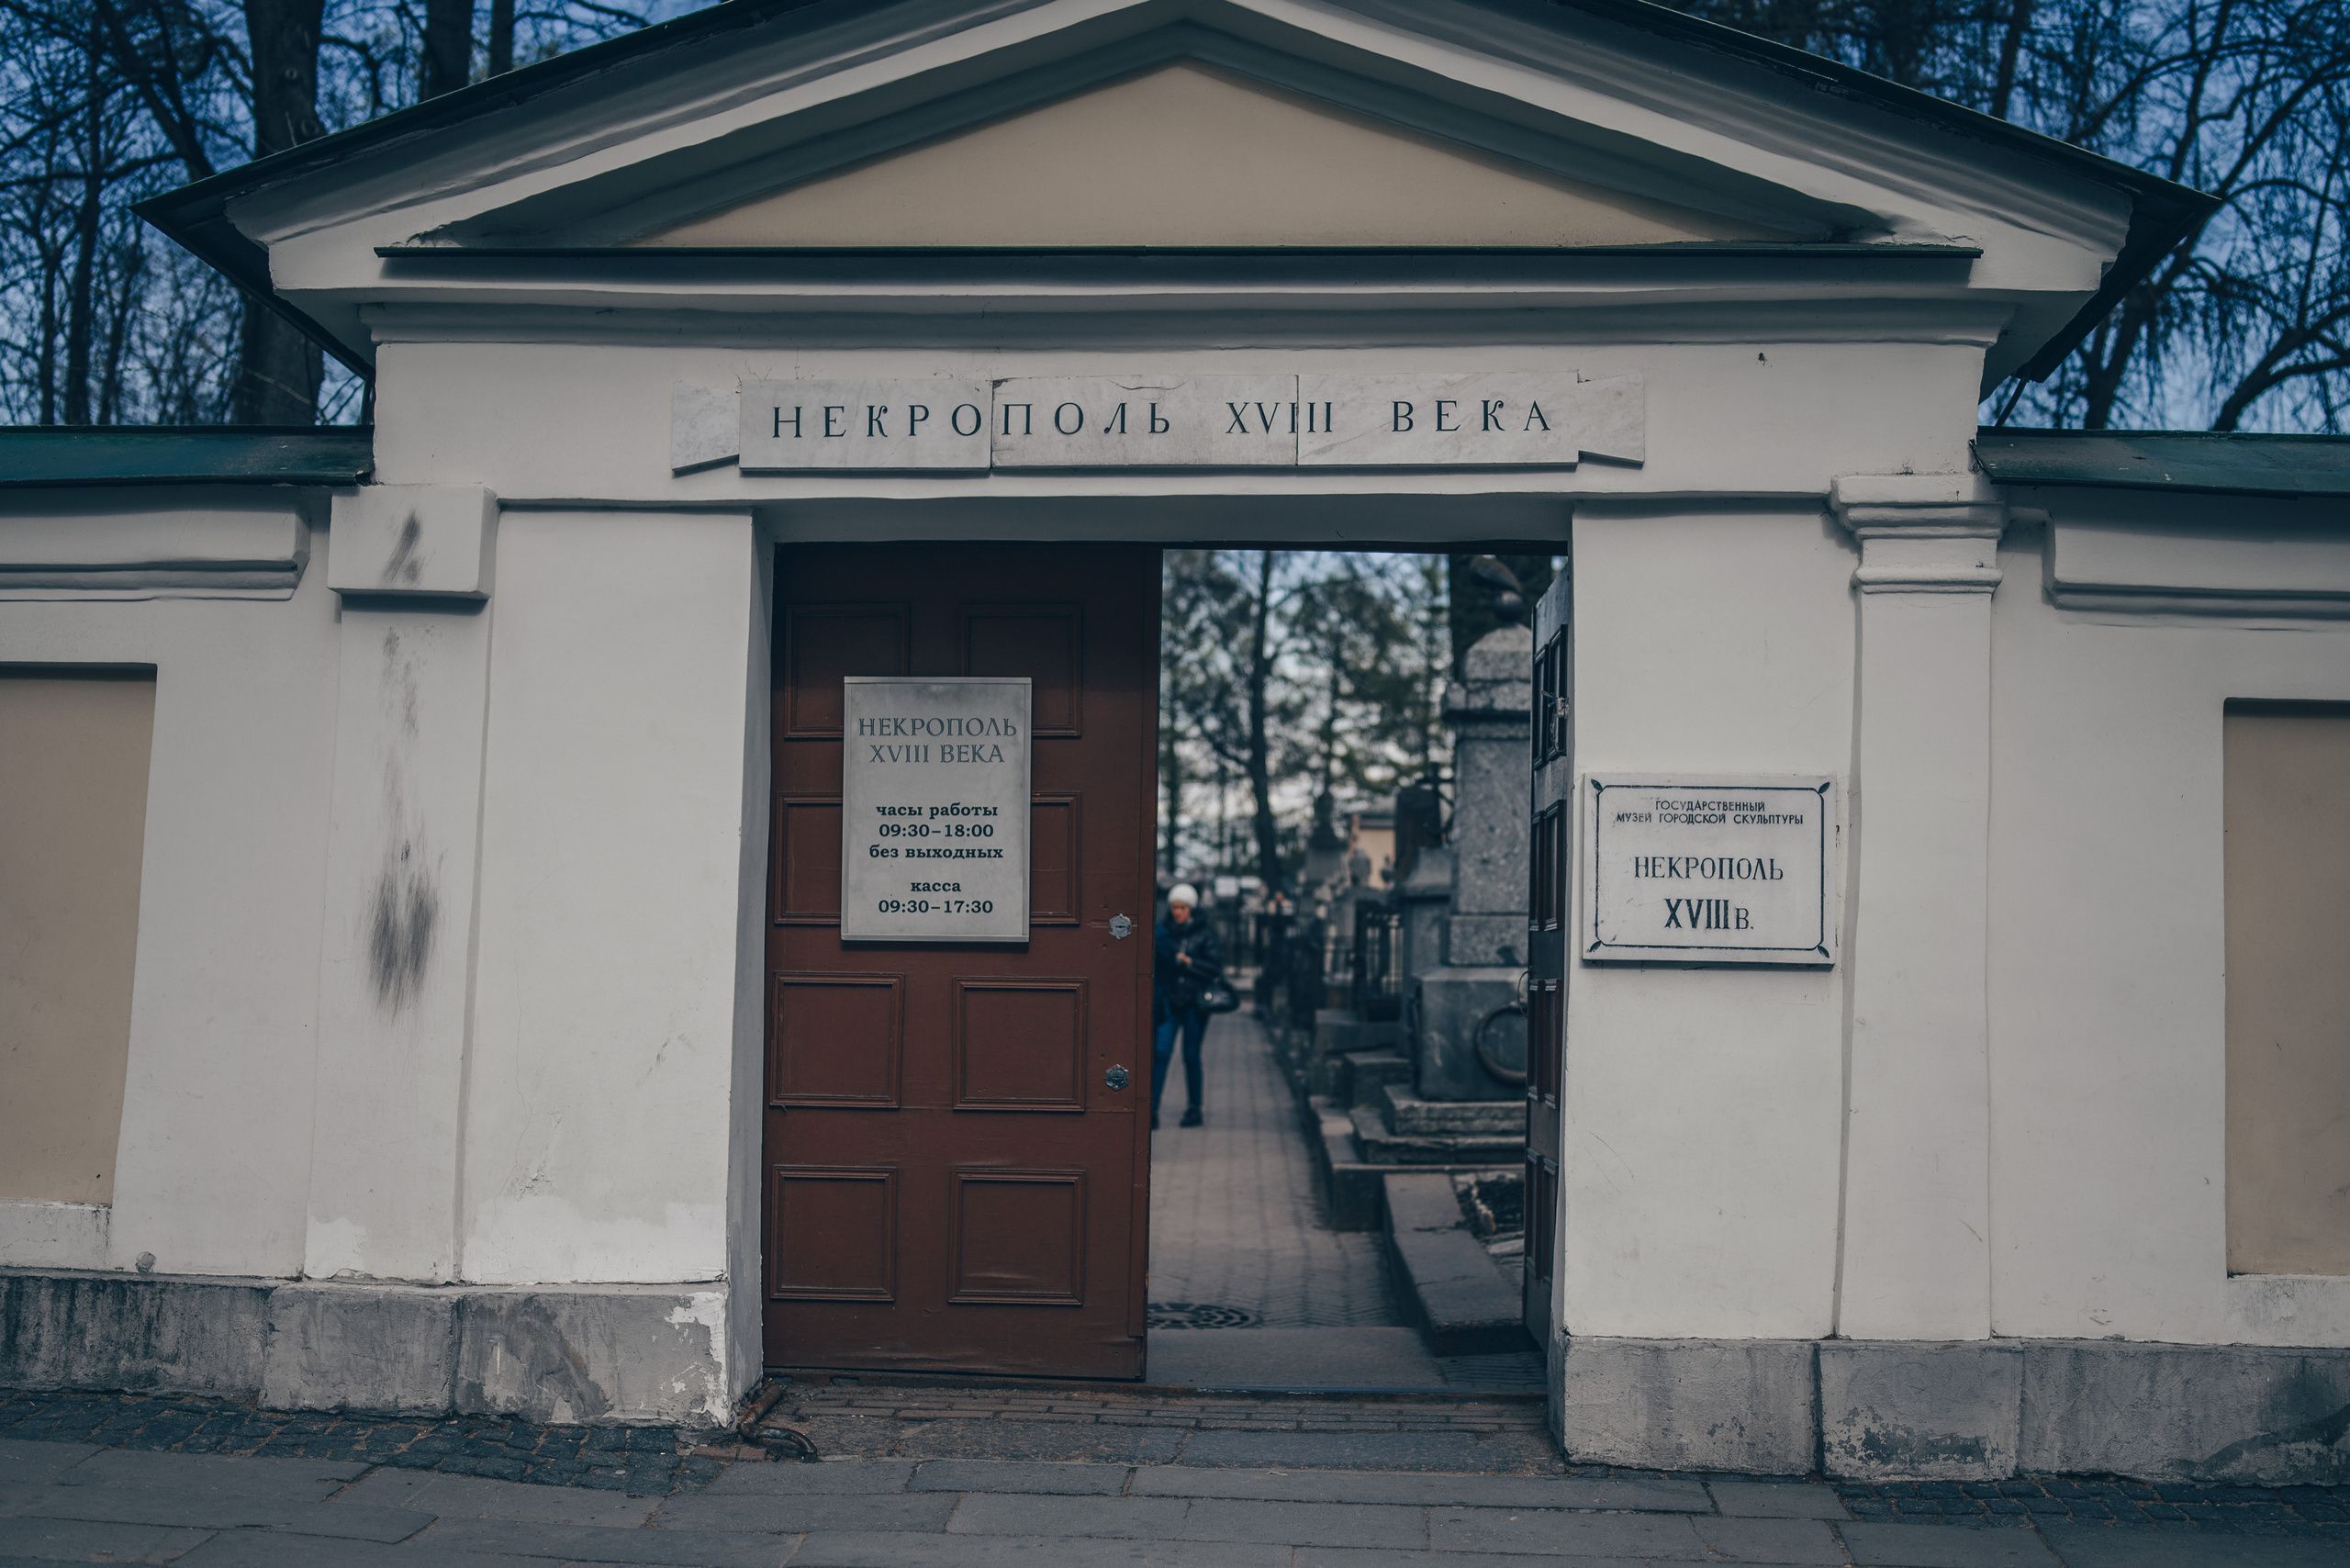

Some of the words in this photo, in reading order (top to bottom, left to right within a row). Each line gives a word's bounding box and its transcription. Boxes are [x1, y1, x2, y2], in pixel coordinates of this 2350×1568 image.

[771, 401, 1170, 439] НЕКРОПОЛЬ
[1225, 401, 1334, 434] XVIII
[1391, 398, 1551, 433] ВЕКА
[858, 717, 1017, 737] НЕКРОПОЛЬ
[869, 744, 930, 763] XVIII
[940, 744, 1005, 763] ВЕКА
[876, 805, 923, 816] часы
[929, 802, 998, 820] работы
[1655, 800, 1765, 812] ГОСУДАРСТВЕННЫЙ
[1617, 812, 1652, 823] МУЗЕЙ
[1659, 812, 1726, 825] ГОРОДСКОЙ
[1733, 813, 1804, 825] СКУЛЬПТУРЫ
[869, 844, 899, 858] без
[905, 847, 1003, 859] выходных
[1634, 856, 1784, 880] НЕКРОПОЛЬ
[911, 881, 961, 892] касса
